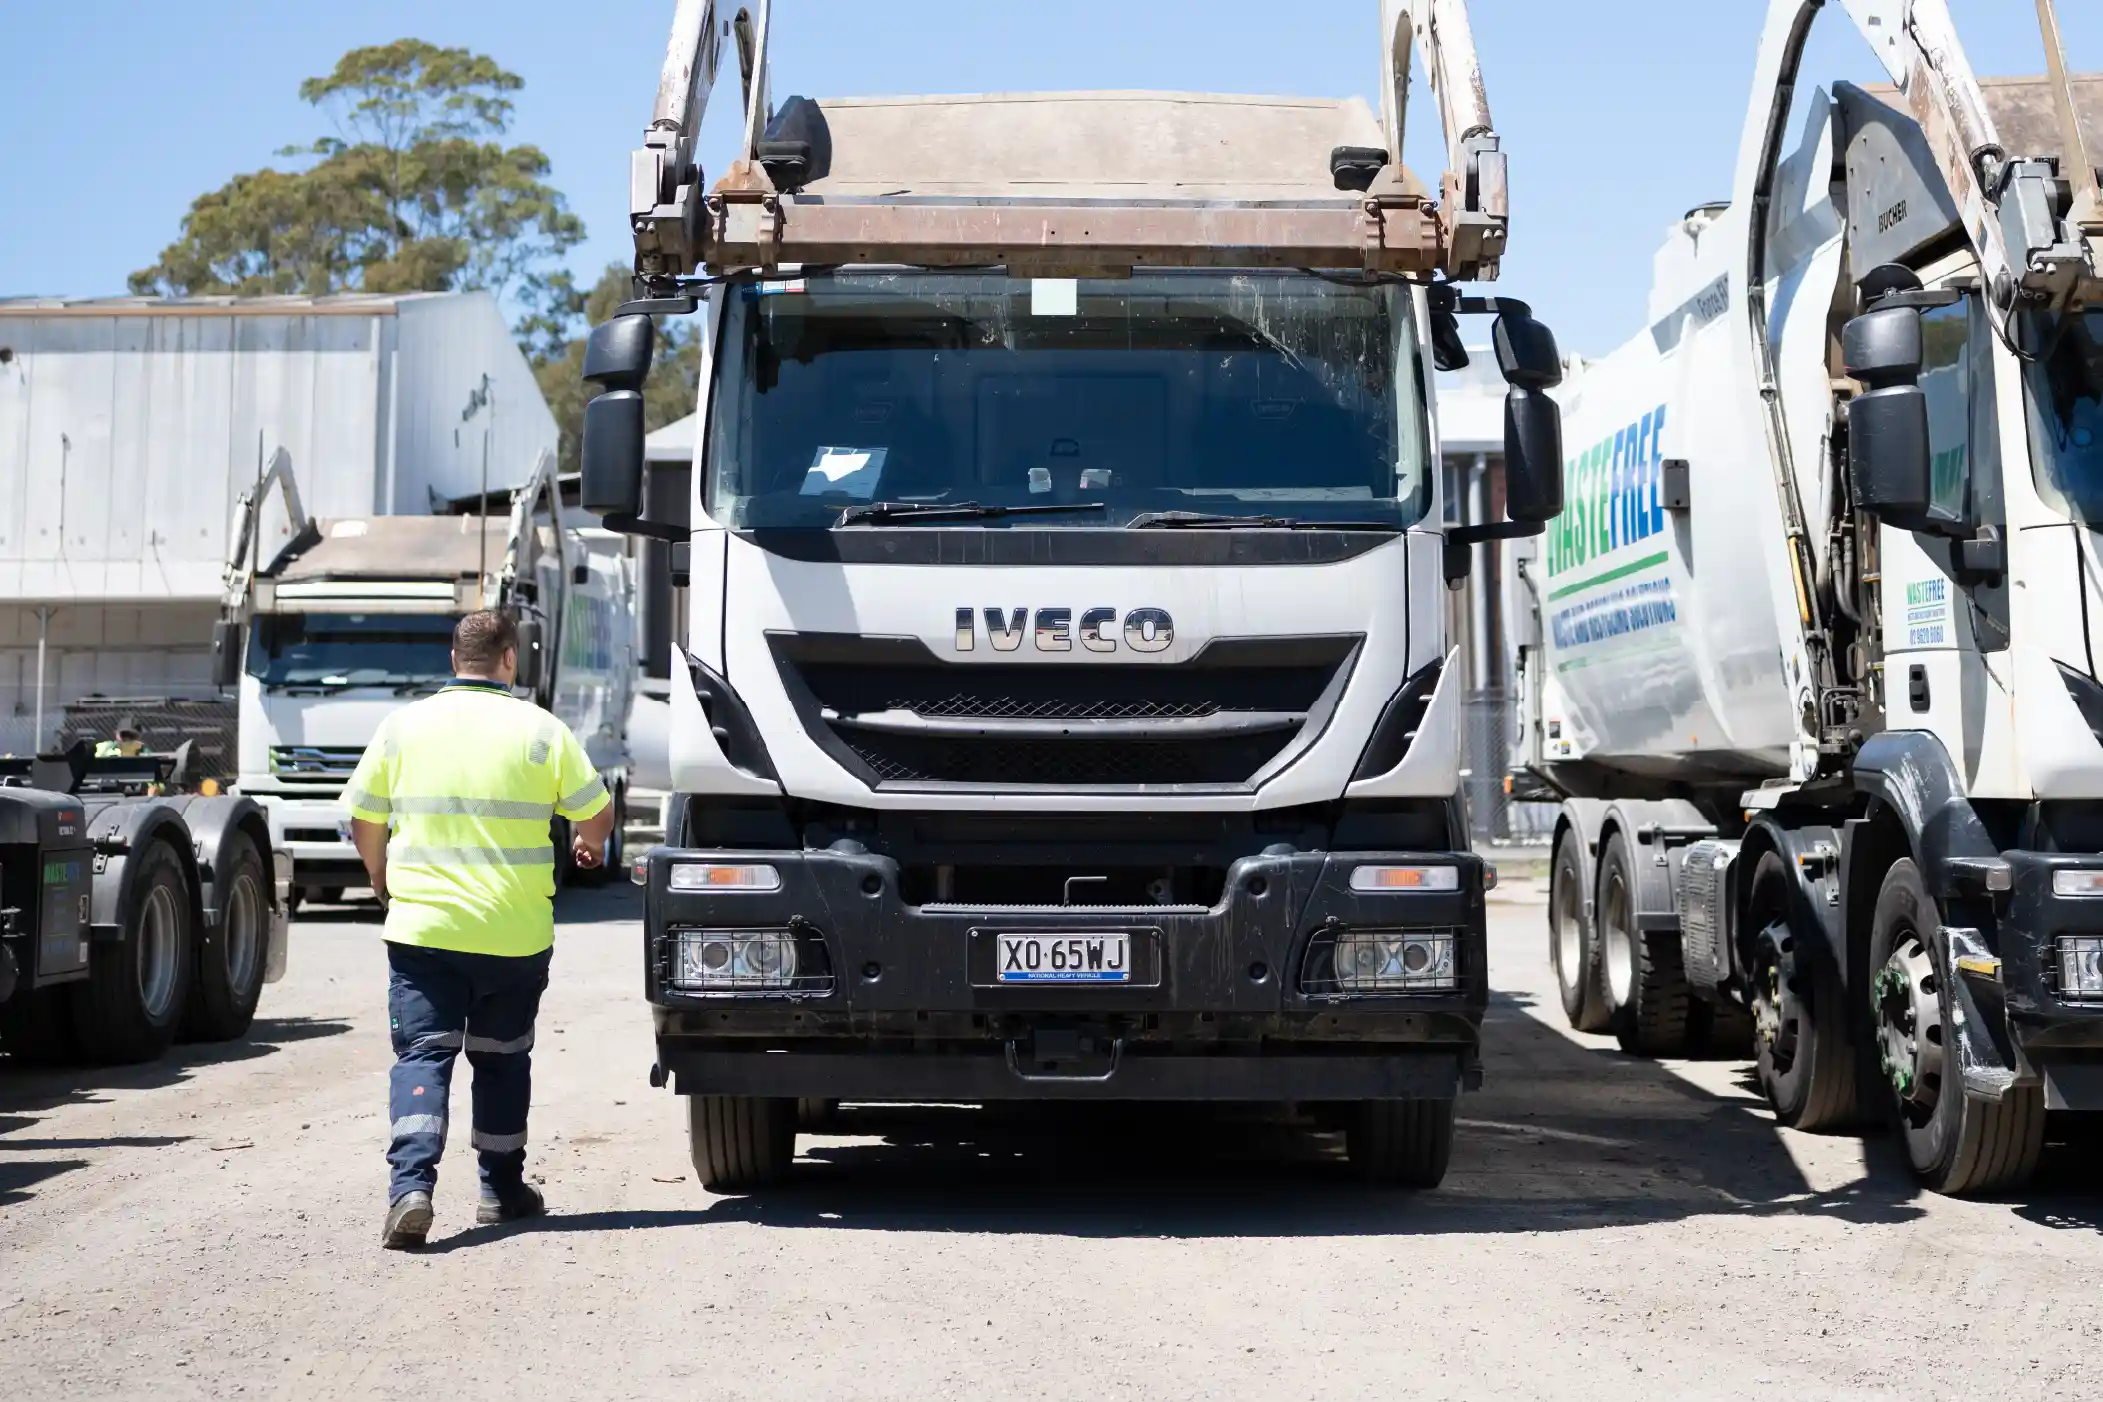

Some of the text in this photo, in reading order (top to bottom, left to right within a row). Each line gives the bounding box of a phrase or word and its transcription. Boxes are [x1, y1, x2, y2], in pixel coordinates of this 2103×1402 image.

[1879, 200, 1907, 235] BUCHER
[1907, 577, 1945, 605] WASTEFREE
[955, 607, 1175, 653] IVECO
